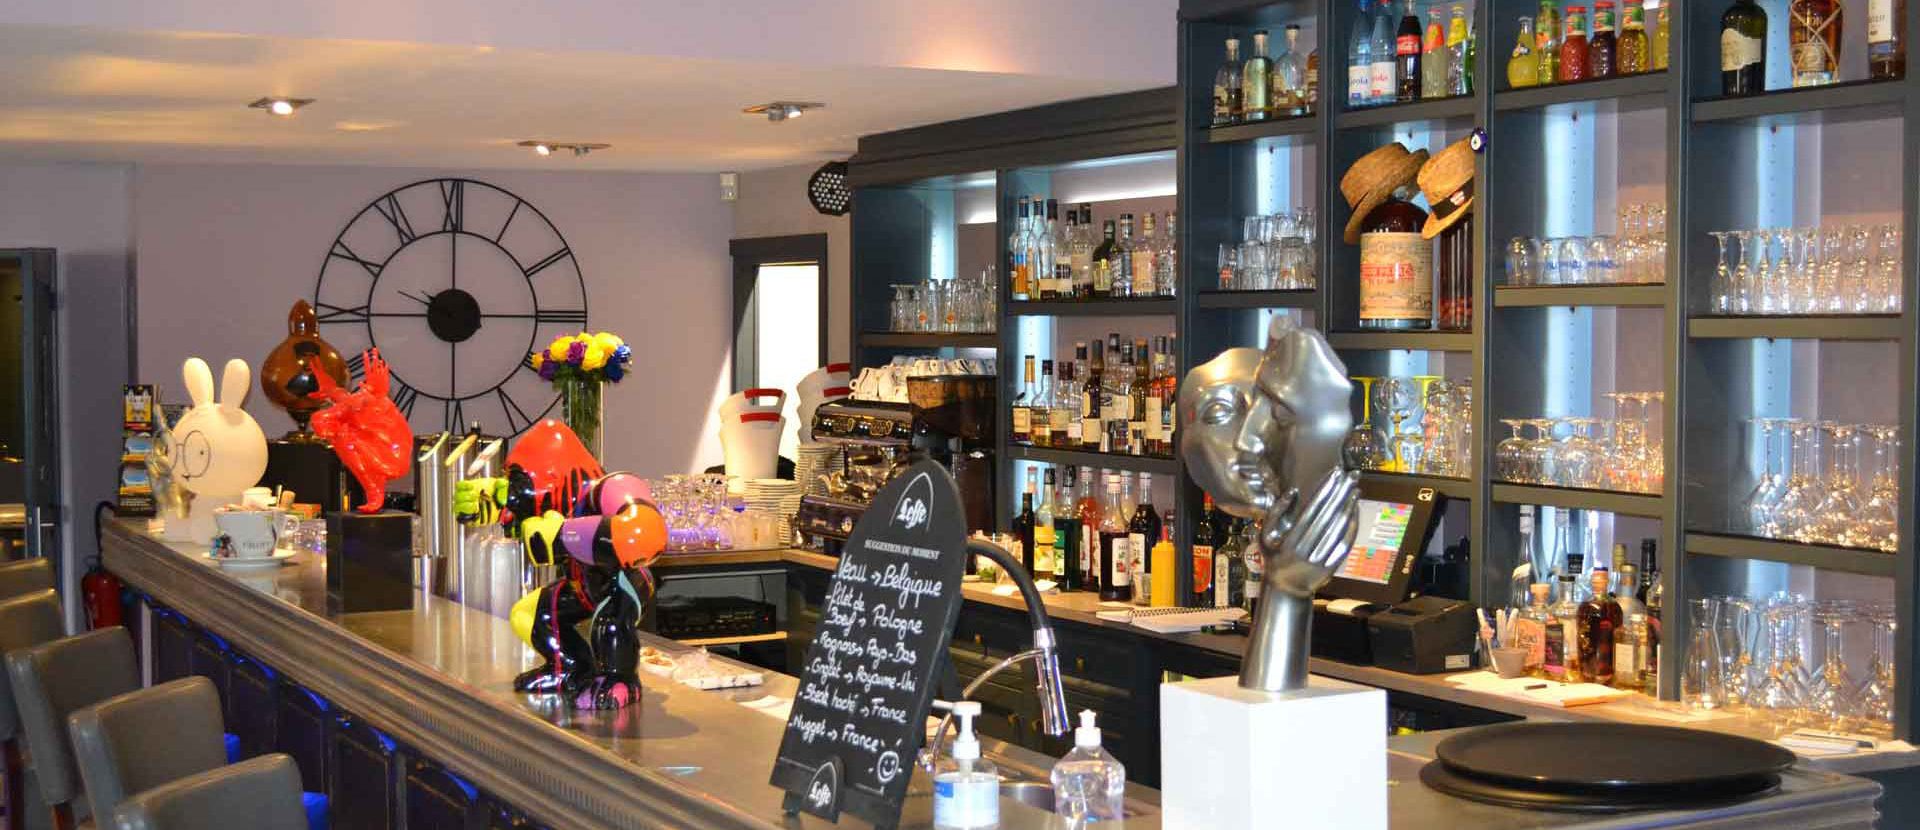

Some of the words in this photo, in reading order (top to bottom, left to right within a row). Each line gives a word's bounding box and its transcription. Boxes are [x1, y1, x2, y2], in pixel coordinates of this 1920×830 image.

[896, 497, 928, 529] Leffe
[880, 562, 943, 610] Belgique
[872, 603, 924, 641] Pologne
[871, 697, 908, 724] France
[793, 713, 826, 744] Nugget
[841, 723, 880, 753] France
[808, 781, 832, 807] Leffe
